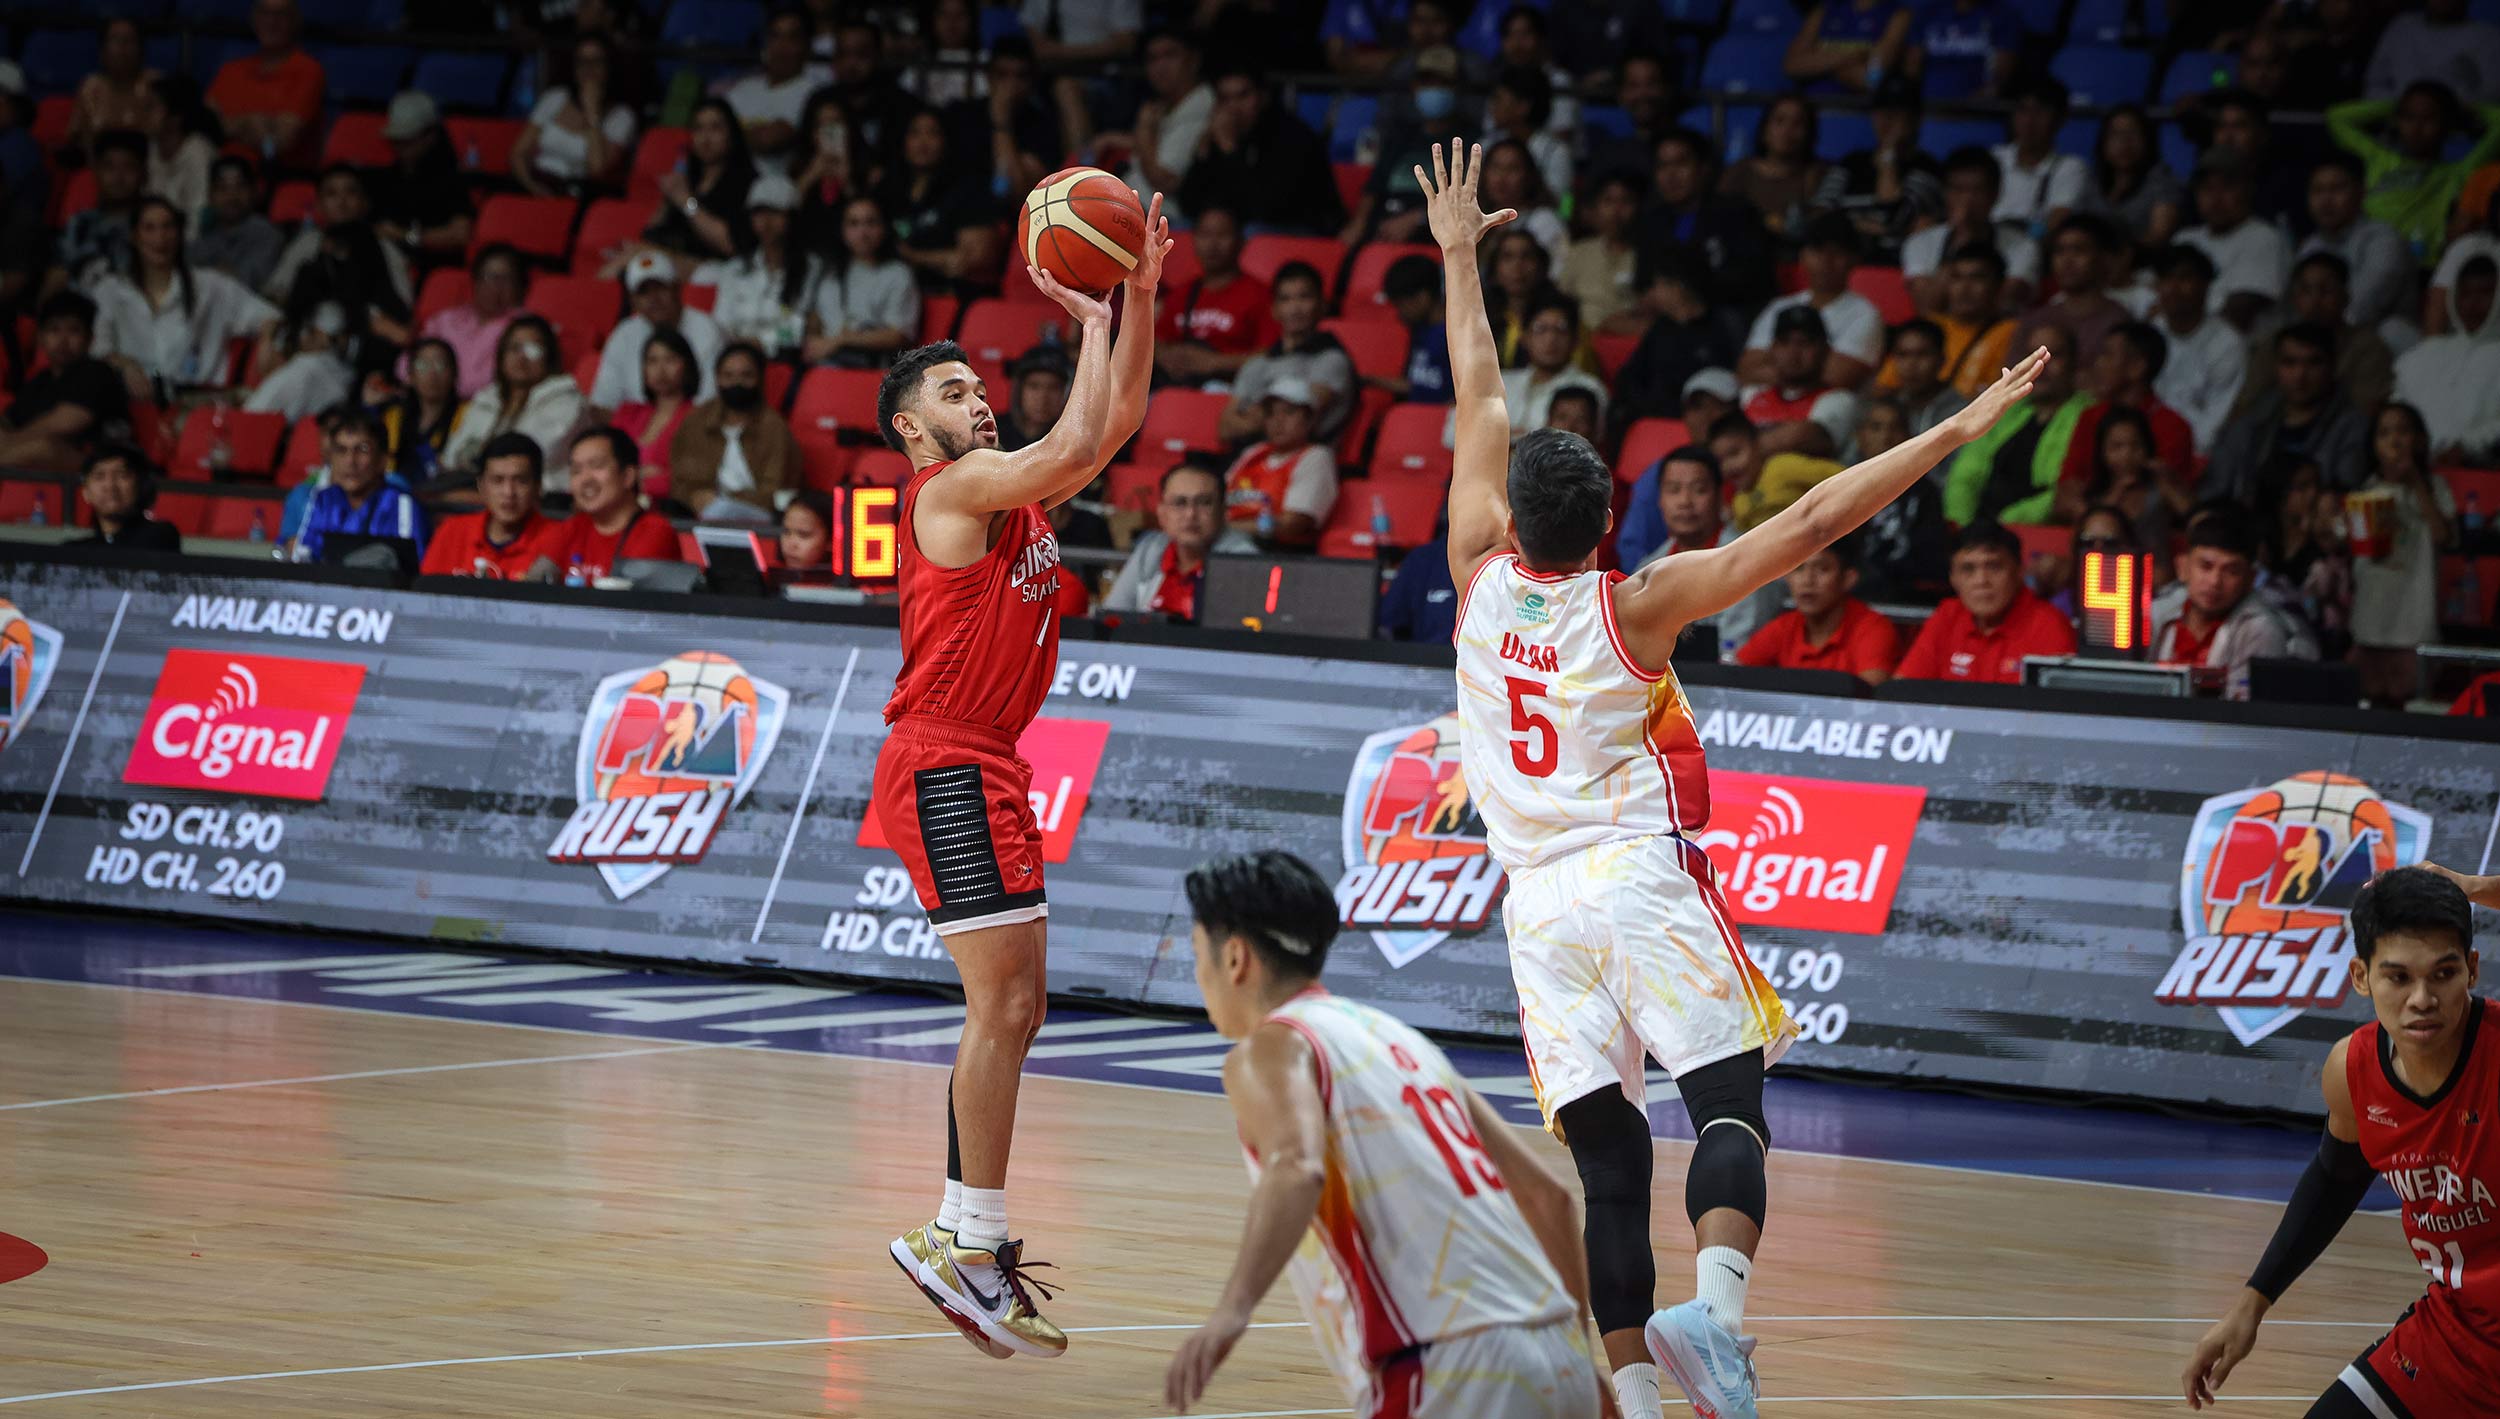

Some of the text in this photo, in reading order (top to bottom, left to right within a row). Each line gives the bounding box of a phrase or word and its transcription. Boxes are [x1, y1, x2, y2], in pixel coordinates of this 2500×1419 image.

[1265, 565, 1283, 615] 1
[172, 594, 393, 643] AVAILABLE ON
[1499, 631, 1560, 673] ULAR
[1079, 663, 1136, 699] ON
[152, 703, 330, 778] Cignal
[597, 692, 748, 783] PBA
[1504, 675, 1558, 778] 5
[1700, 710, 1953, 764] AVAILABLE ON
[119, 802, 170, 841] SD
[1366, 752, 1487, 843] PB
[547, 788, 734, 863] RUSH
[86, 846, 285, 900] HD CH. 260
[856, 866, 907, 905] SD
[1335, 854, 1506, 928] RUSH
[821, 912, 878, 951] HD
[1750, 946, 1844, 992] H.90
[2154, 926, 2357, 1008] RUSH
[1401, 1083, 1505, 1198] 19
[2382, 1164, 2497, 1208] INEBRA
[2417, 1205, 2491, 1233] MIGUEL
[2410, 1236, 2465, 1290] 31
